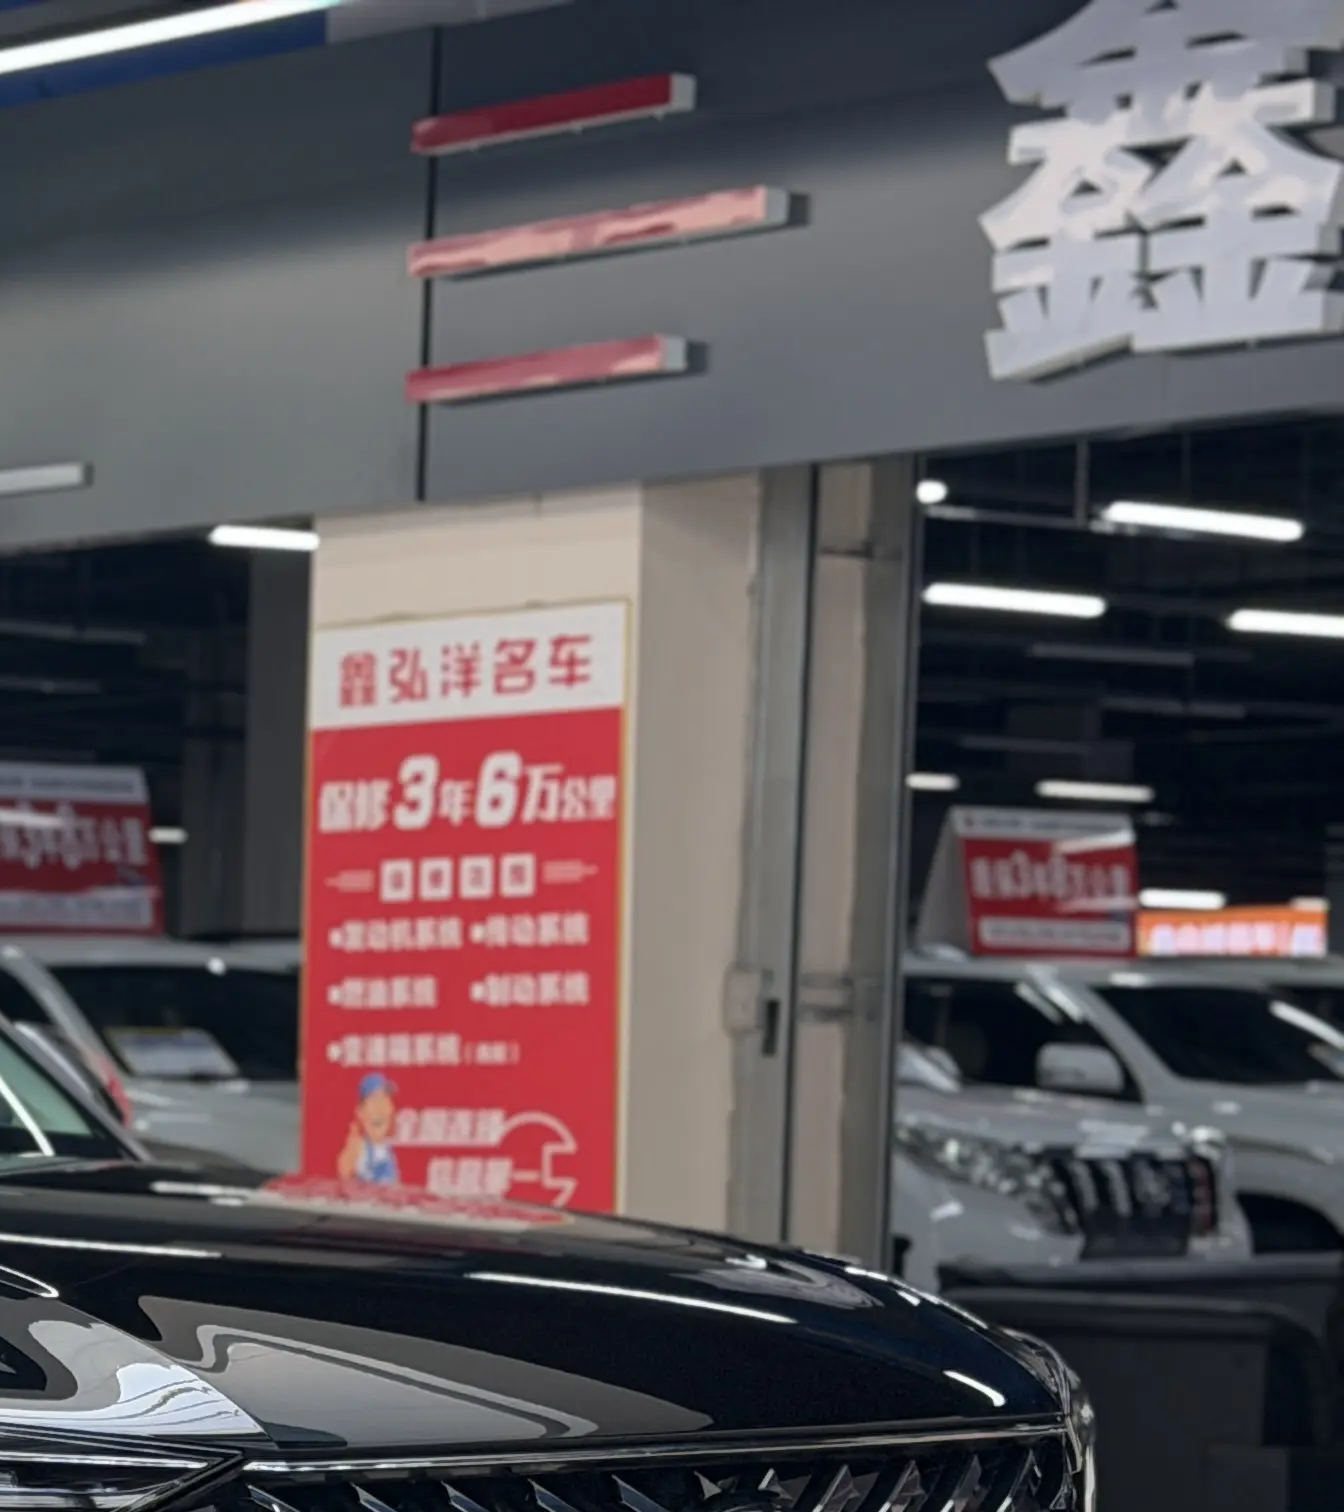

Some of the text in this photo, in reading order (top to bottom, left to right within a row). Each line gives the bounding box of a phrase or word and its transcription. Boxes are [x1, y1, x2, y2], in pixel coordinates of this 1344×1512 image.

[978, 0, 1344, 380] 鑫
[338, 634, 592, 709] 鑫弘洋名车
